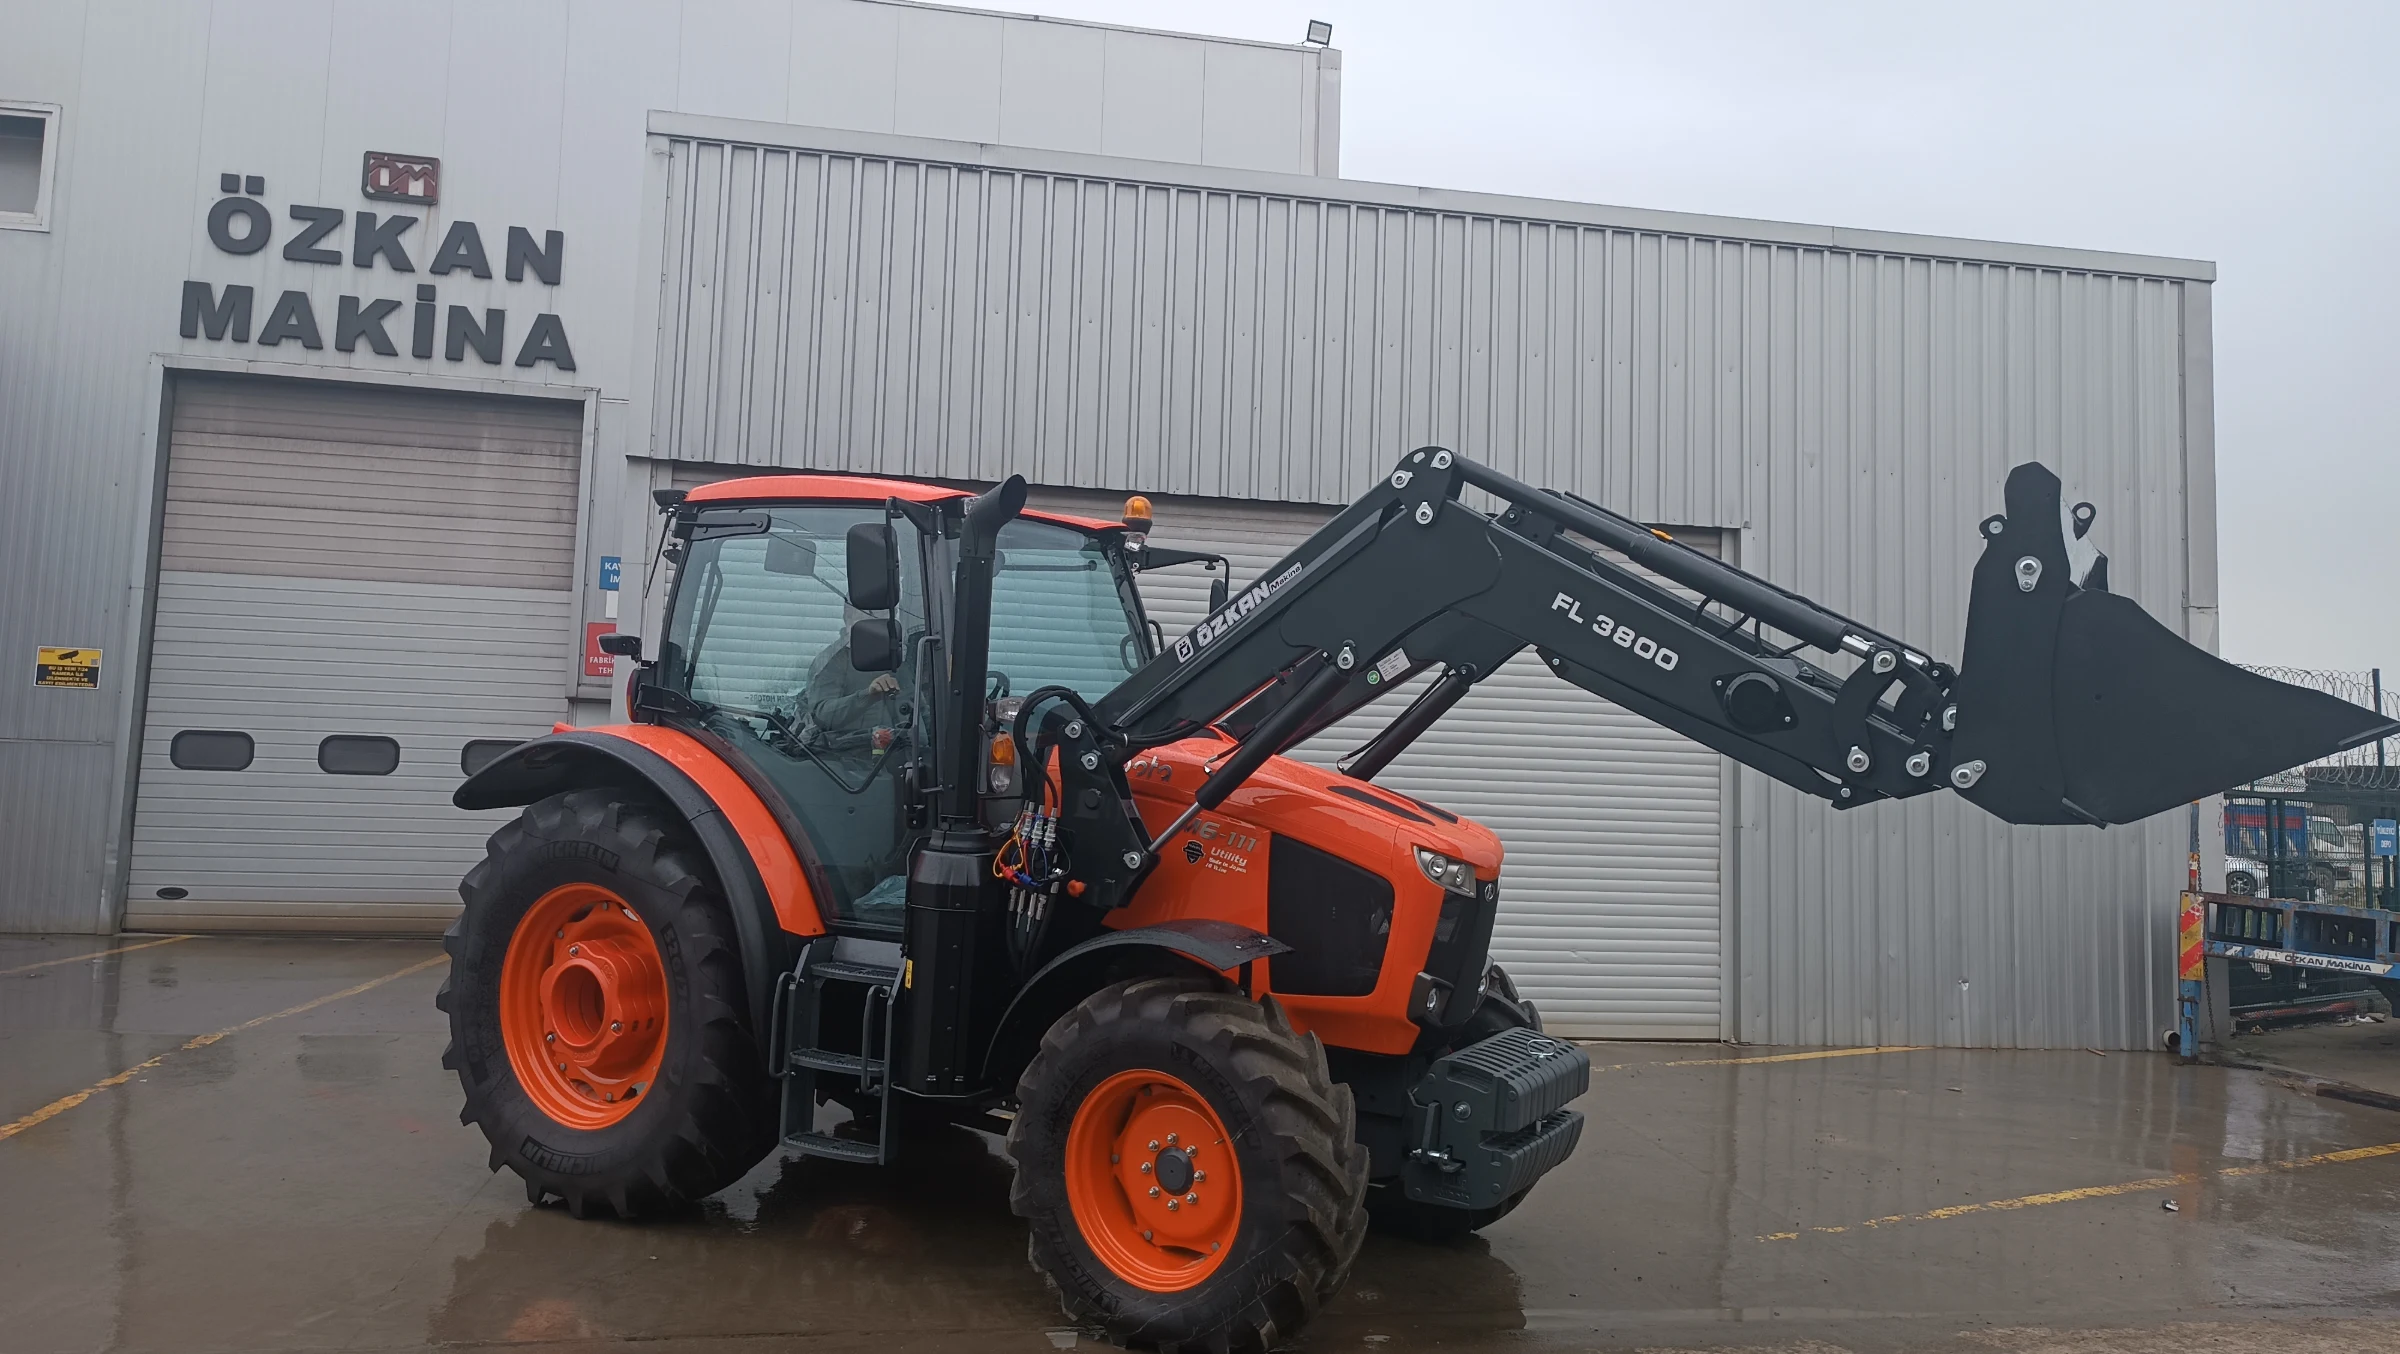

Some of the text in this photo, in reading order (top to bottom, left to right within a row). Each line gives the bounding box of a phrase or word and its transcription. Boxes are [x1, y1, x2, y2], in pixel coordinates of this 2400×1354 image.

[207, 172, 564, 286] ÖZKAN
[180, 280, 577, 372] MAKİNA
[1196, 580, 1272, 647] ÖZKAN
[1270, 566, 1301, 592] Makina
[1551, 592, 1679, 671] FL 3800
[598, 666, 613, 674] TEH
[1210, 847, 1248, 867] Utility
[2284, 952, 2372, 972] ÖZKAN MAKİNA
